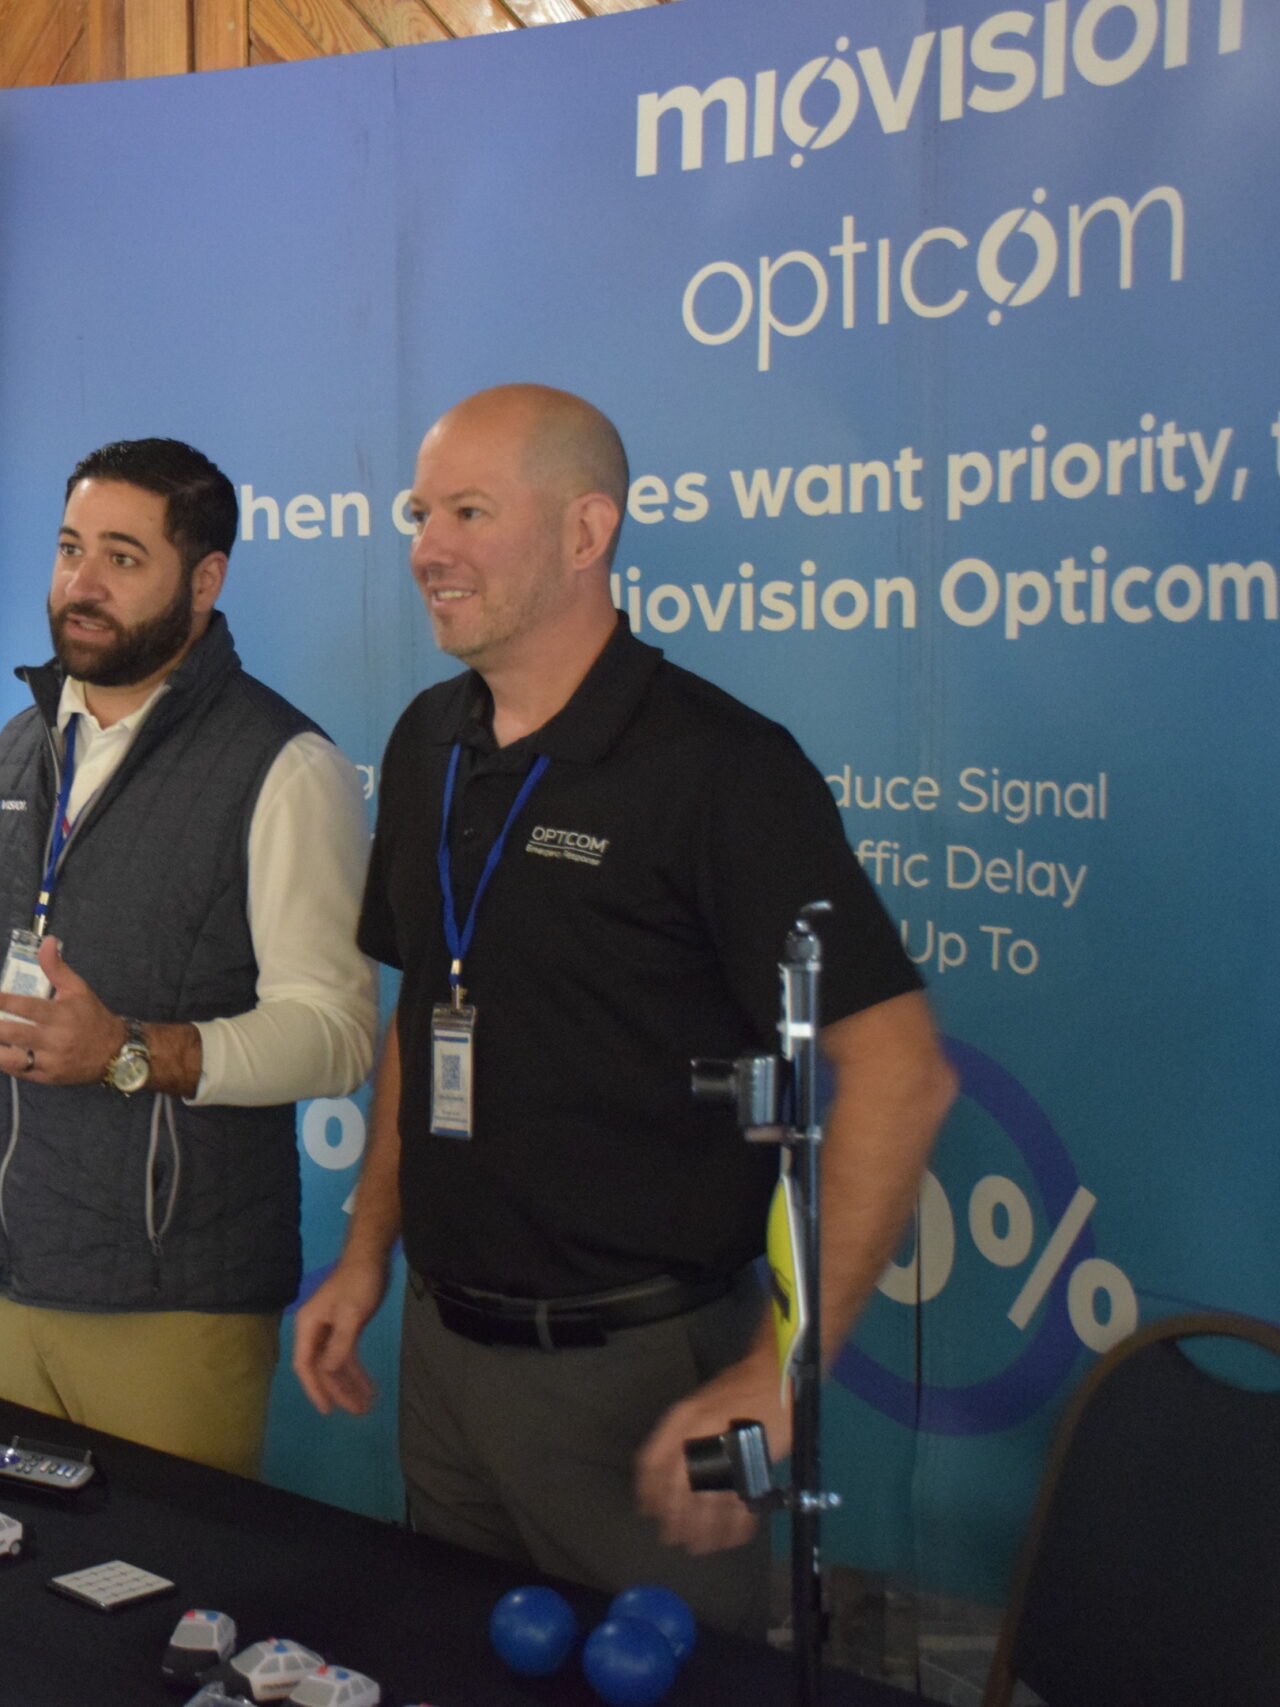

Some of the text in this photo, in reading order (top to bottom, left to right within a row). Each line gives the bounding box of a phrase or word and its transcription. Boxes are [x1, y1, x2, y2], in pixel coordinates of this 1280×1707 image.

[682, 186, 1184, 371] opticom
[235, 484, 370, 541] hen
[729, 446, 923, 519] want
[947, 412, 1248, 521] priority,
[611, 545, 1278, 640] iovision Opticom
[824, 764, 1107, 824] duce Signal
[853, 839, 1087, 908] ffic Delay
[900, 919, 1039, 975] Up To
